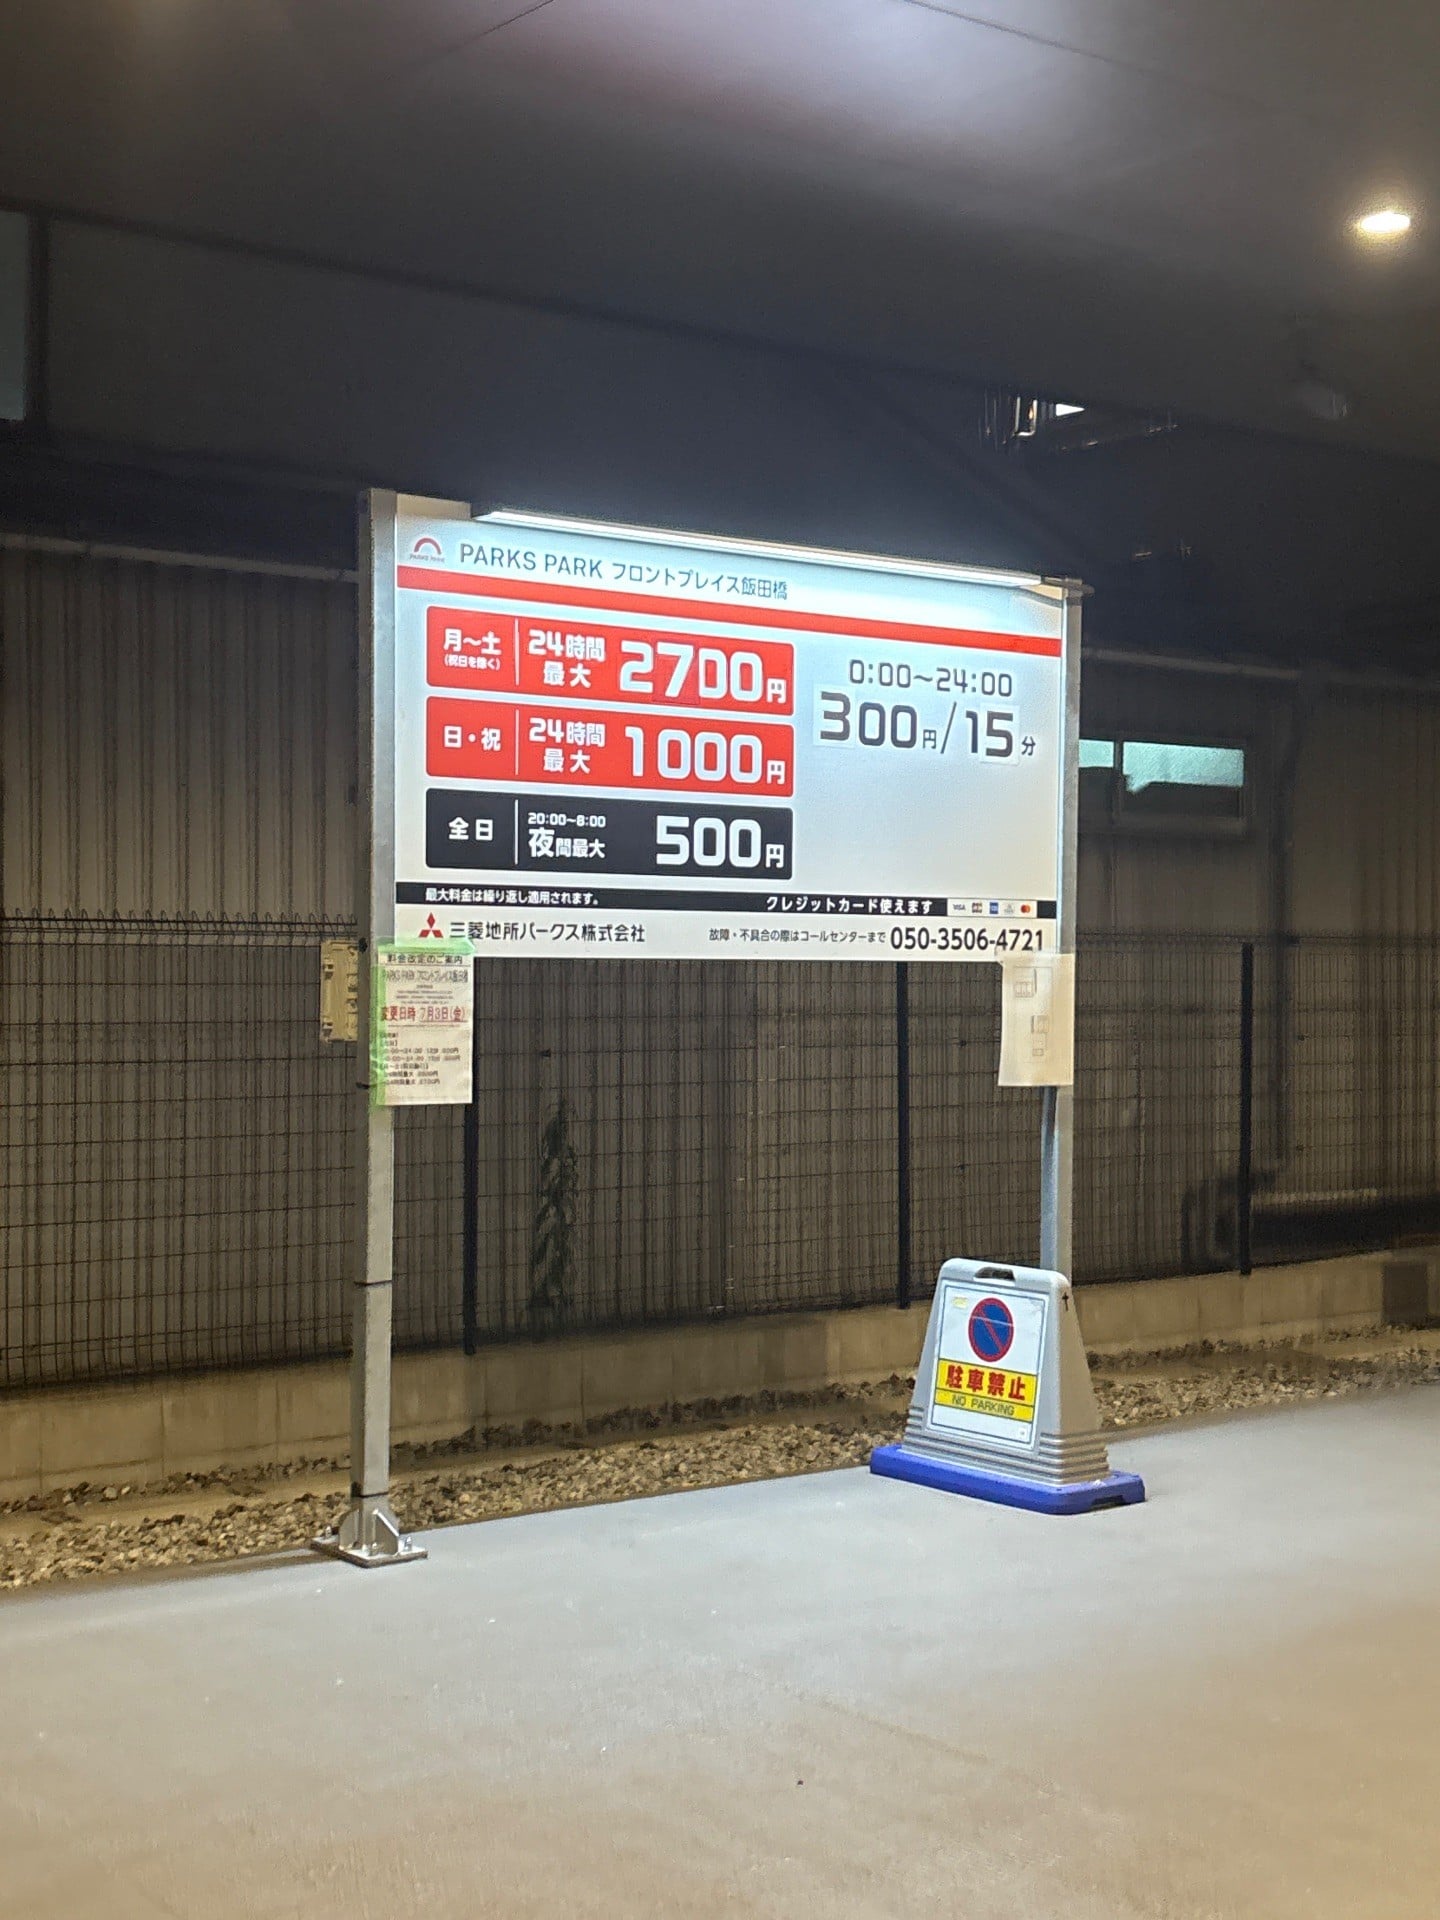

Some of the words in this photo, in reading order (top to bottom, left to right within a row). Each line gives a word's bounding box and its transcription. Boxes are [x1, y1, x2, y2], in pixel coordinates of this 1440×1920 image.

[459, 543, 536, 571] PARKS
[544, 554, 603, 578] PARK
[612, 561, 788, 600] フロントプレイス飯田橋
[528, 629, 606, 662] 24時間
[543, 663, 591, 688] 最大
[443, 725, 501, 751] 日・祝
[528, 717, 606, 748] 24時間
[543, 748, 591, 774] 最大
[448, 816, 494, 841] 全日
[528, 826, 606, 859] 夜間最大
[425, 887, 599, 906] 最大料金は繰り返し適用されます。
[766, 895, 933, 915] クレジットカード使えます
[449, 920, 646, 944] 三菱地所パークス株式会社
[709, 927, 886, 944] 故障・不具合の際はコールセンターまで
[890, 926, 1043, 951] 050-3506-4721
[946, 1365, 1025, 1401] 駐車禁止
[952, 1394, 967, 1408] NO
[971, 1398, 1015, 1416] PARKING
